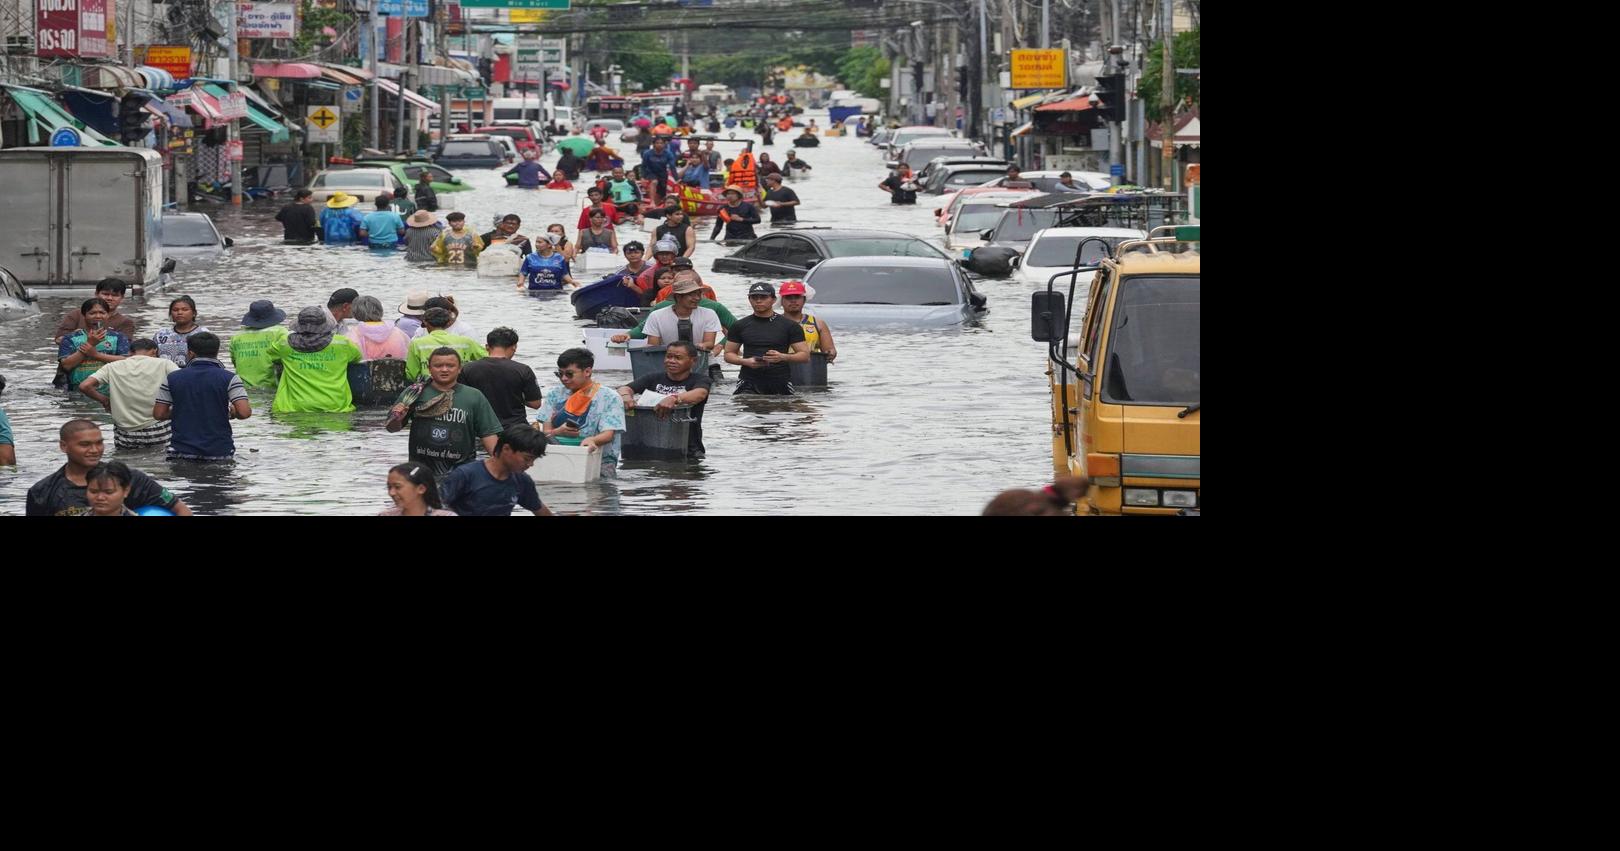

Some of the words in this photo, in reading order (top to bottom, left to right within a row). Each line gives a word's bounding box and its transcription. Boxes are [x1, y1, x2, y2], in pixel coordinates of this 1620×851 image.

[40, 29, 75, 50] กระจก
[448, 250, 465, 263] 23
[432, 428, 447, 439] DC
